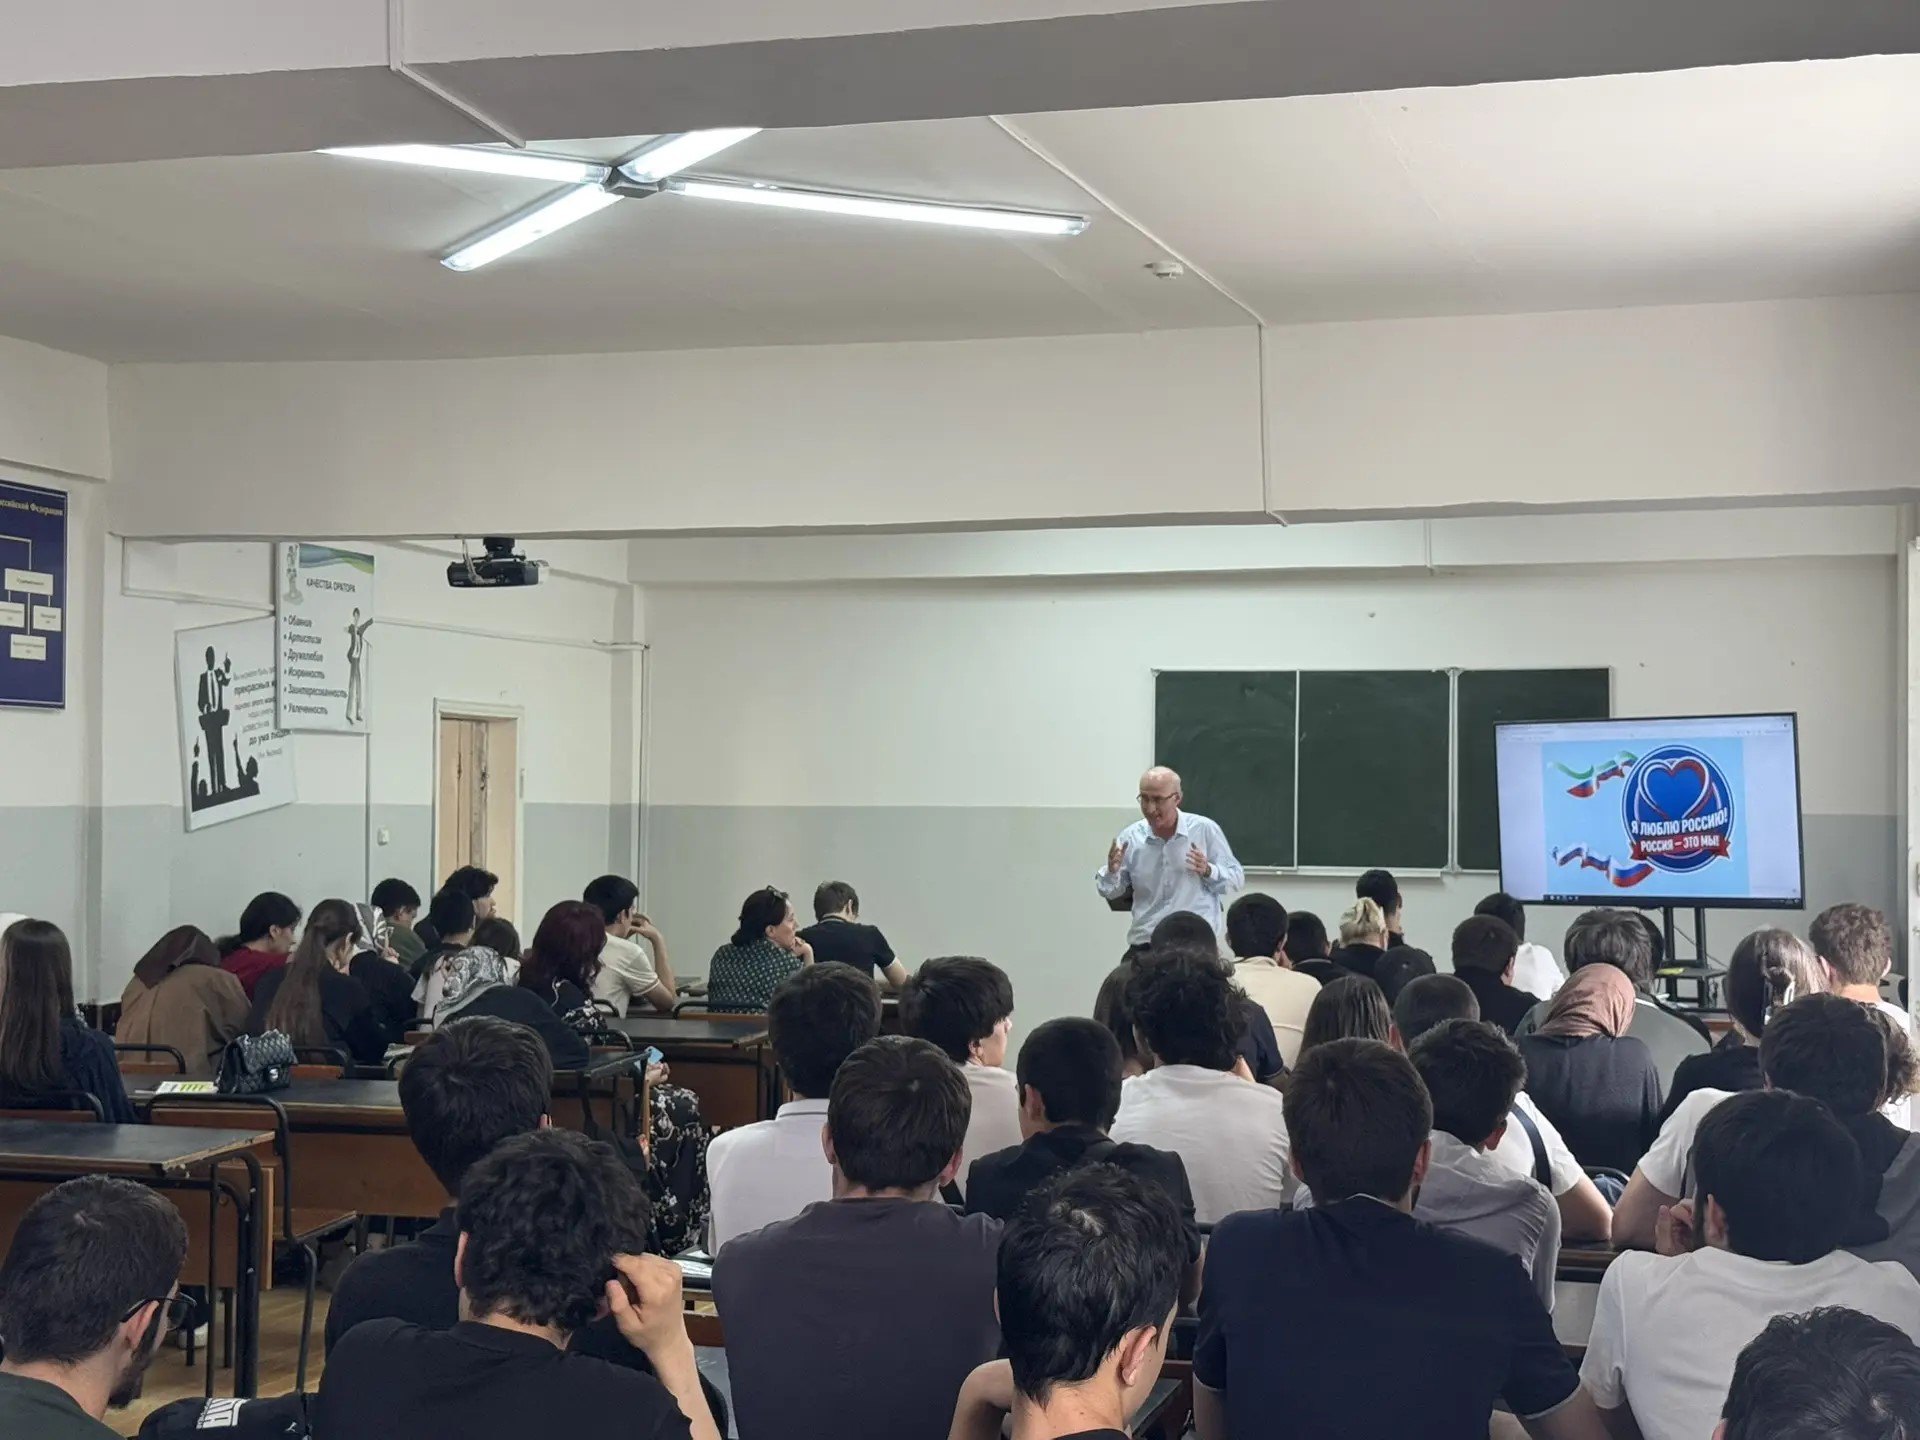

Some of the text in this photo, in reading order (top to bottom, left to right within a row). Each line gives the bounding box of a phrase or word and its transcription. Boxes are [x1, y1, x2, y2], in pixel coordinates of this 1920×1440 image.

[1631, 806, 1729, 836] Я ЛЮБЛЮ РОССИЮ!
[1640, 838, 1674, 853] РОССИЯ
[1683, 835, 1700, 849] ЭТО
[1701, 834, 1720, 847] МЫ!
